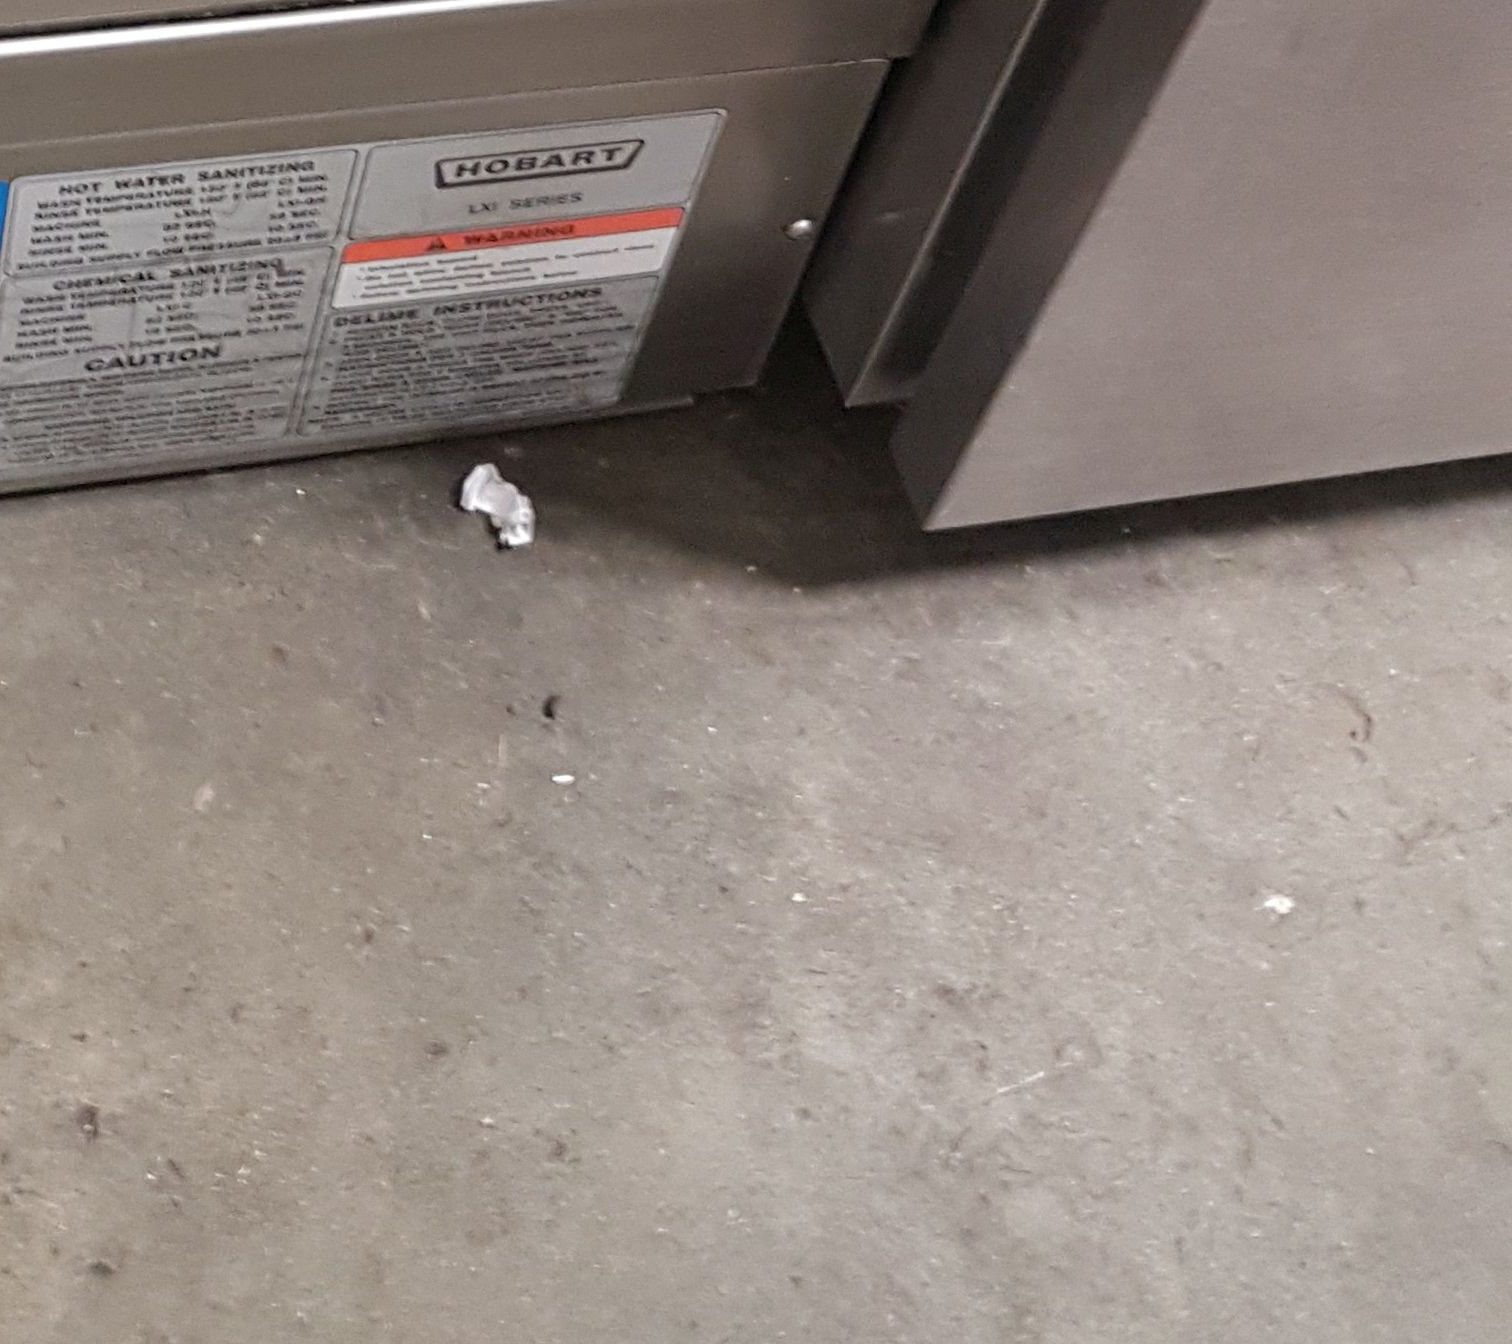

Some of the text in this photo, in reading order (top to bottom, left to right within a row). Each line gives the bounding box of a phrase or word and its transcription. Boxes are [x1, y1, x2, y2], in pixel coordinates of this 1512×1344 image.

[455, 147, 623, 178] HOBART
[59, 182, 102, 195] HOT
[115, 173, 186, 190] WATER
[198, 161, 315, 182] SANITIZING
[509, 192, 583, 210] SERIES
[464, 224, 575, 244] WARNING
[85, 344, 222, 372] CAUTION
